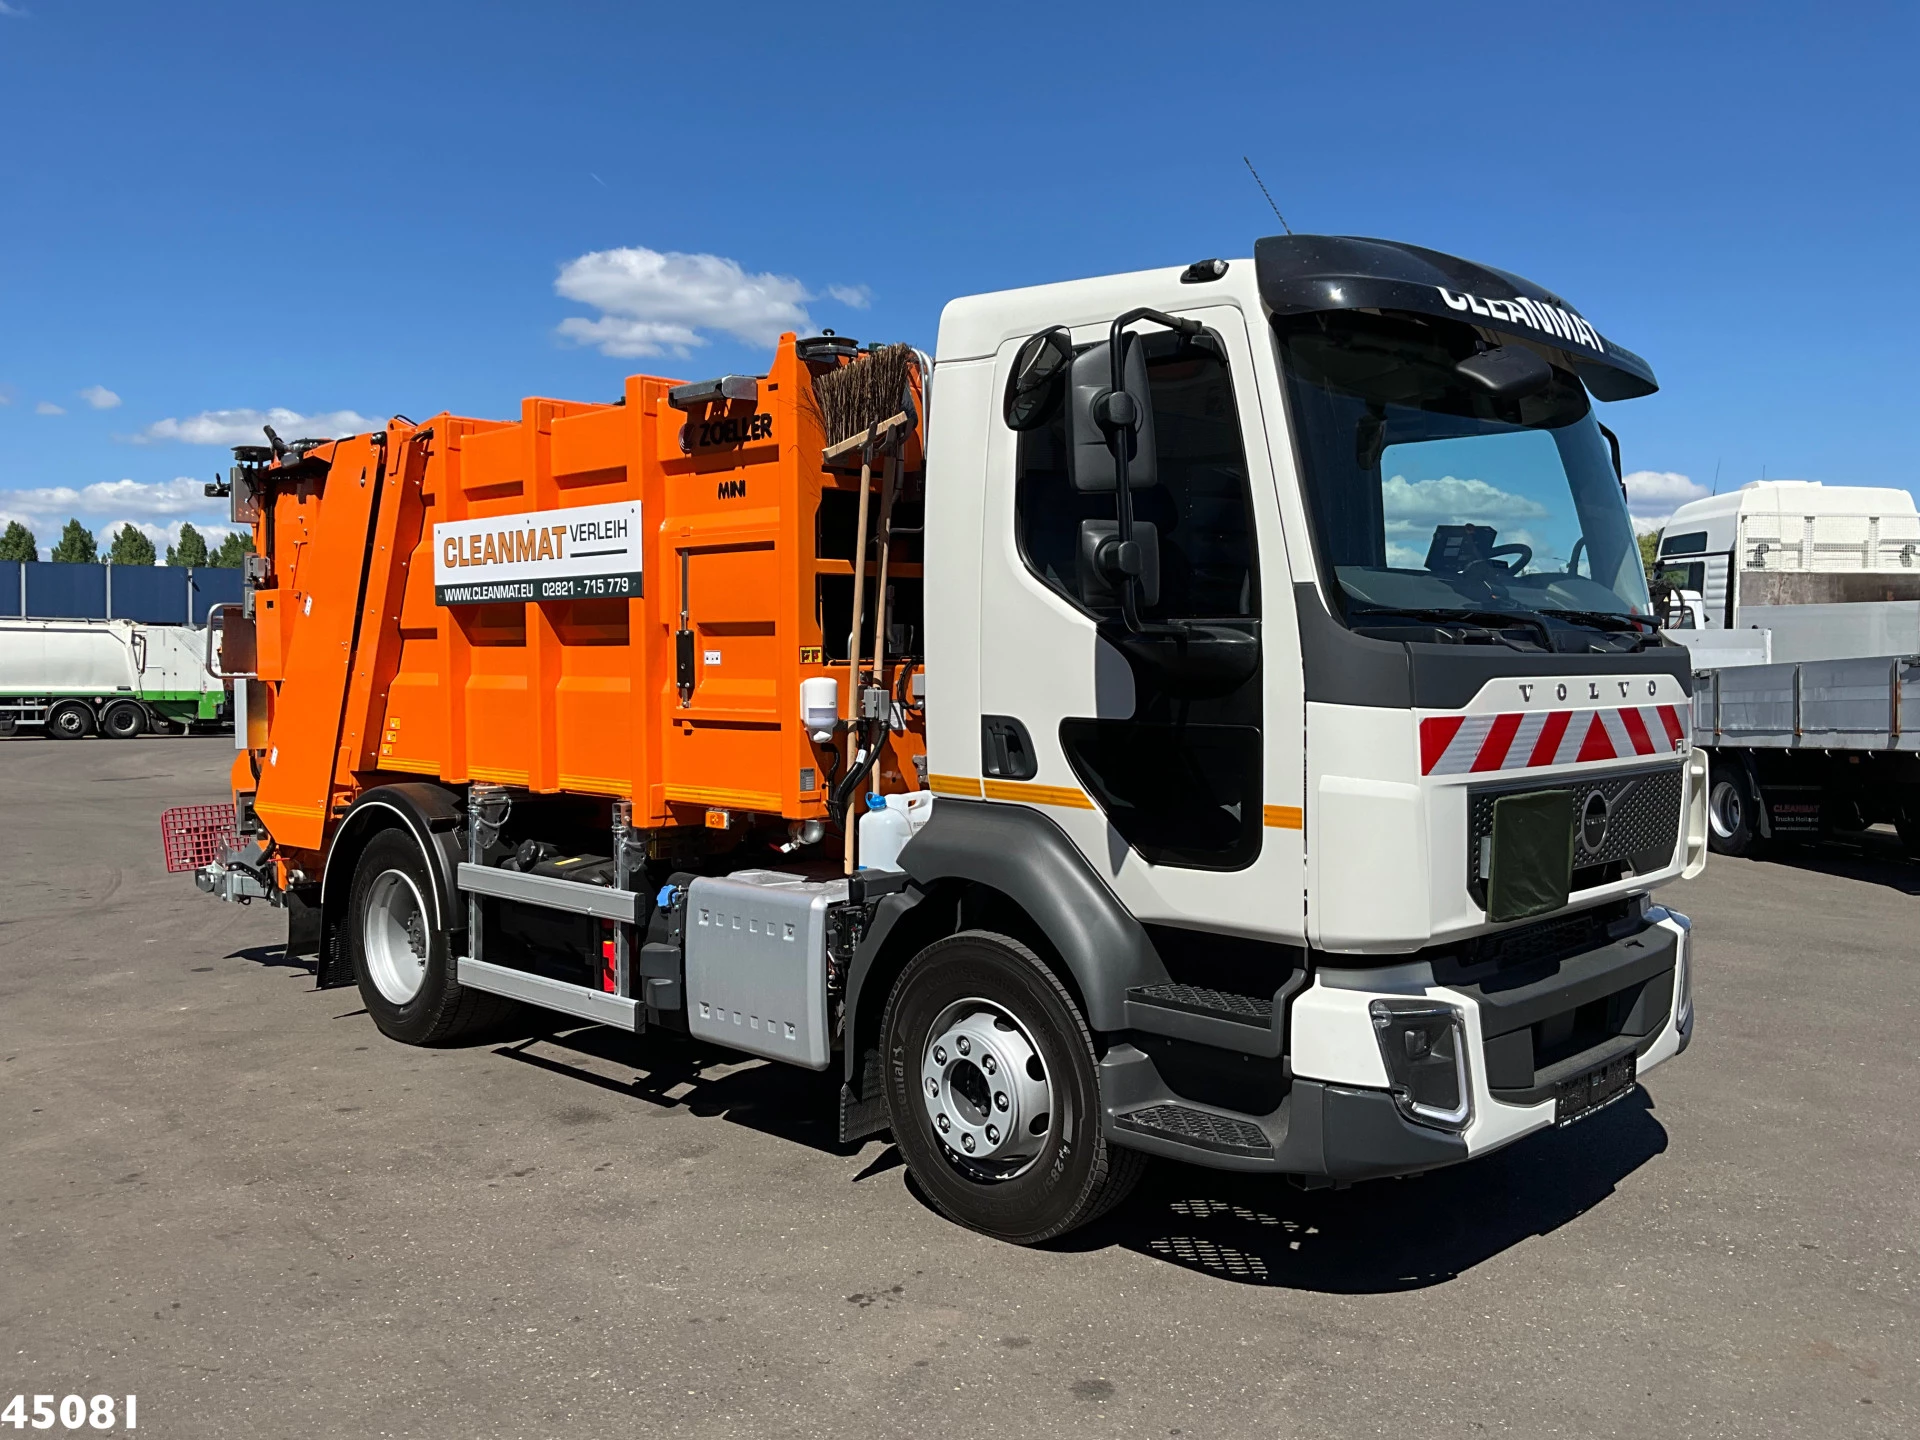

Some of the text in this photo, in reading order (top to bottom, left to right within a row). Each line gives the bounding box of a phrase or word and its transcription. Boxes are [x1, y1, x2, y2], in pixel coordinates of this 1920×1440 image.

[699, 413, 773, 447] ZOELLER
[718, 480, 746, 500] MINI
[444, 518, 628, 568] CLEANMAT VERLEIH
[444, 583, 534, 602] WWW.CLEANMAT.EU
[542, 580, 574, 597] 02821
[583, 579, 605, 595] 715
[607, 577, 629, 594] 779
[1518, 680, 1657, 702] VOLVO
[1675, 738, 1687, 755] FL
